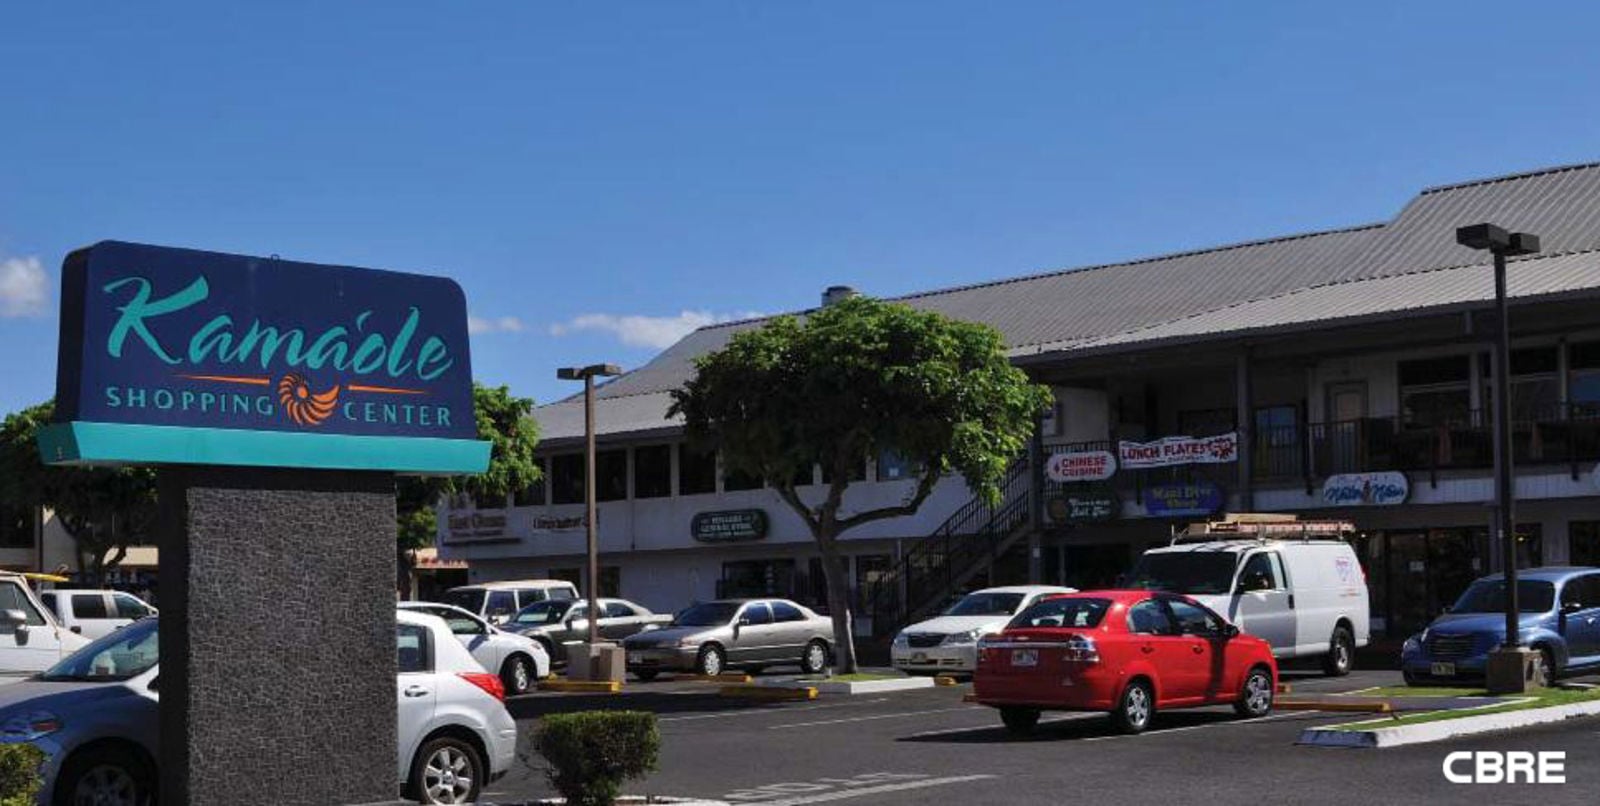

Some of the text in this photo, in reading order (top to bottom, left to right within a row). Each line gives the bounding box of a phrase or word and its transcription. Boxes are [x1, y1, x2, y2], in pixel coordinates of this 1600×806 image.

[106, 387, 451, 427] SHOPPING CENTER
[1122, 447, 1160, 461] LUNCH
[1062, 455, 1107, 468] CHINESE
[1062, 467, 1104, 477] CUISINE
